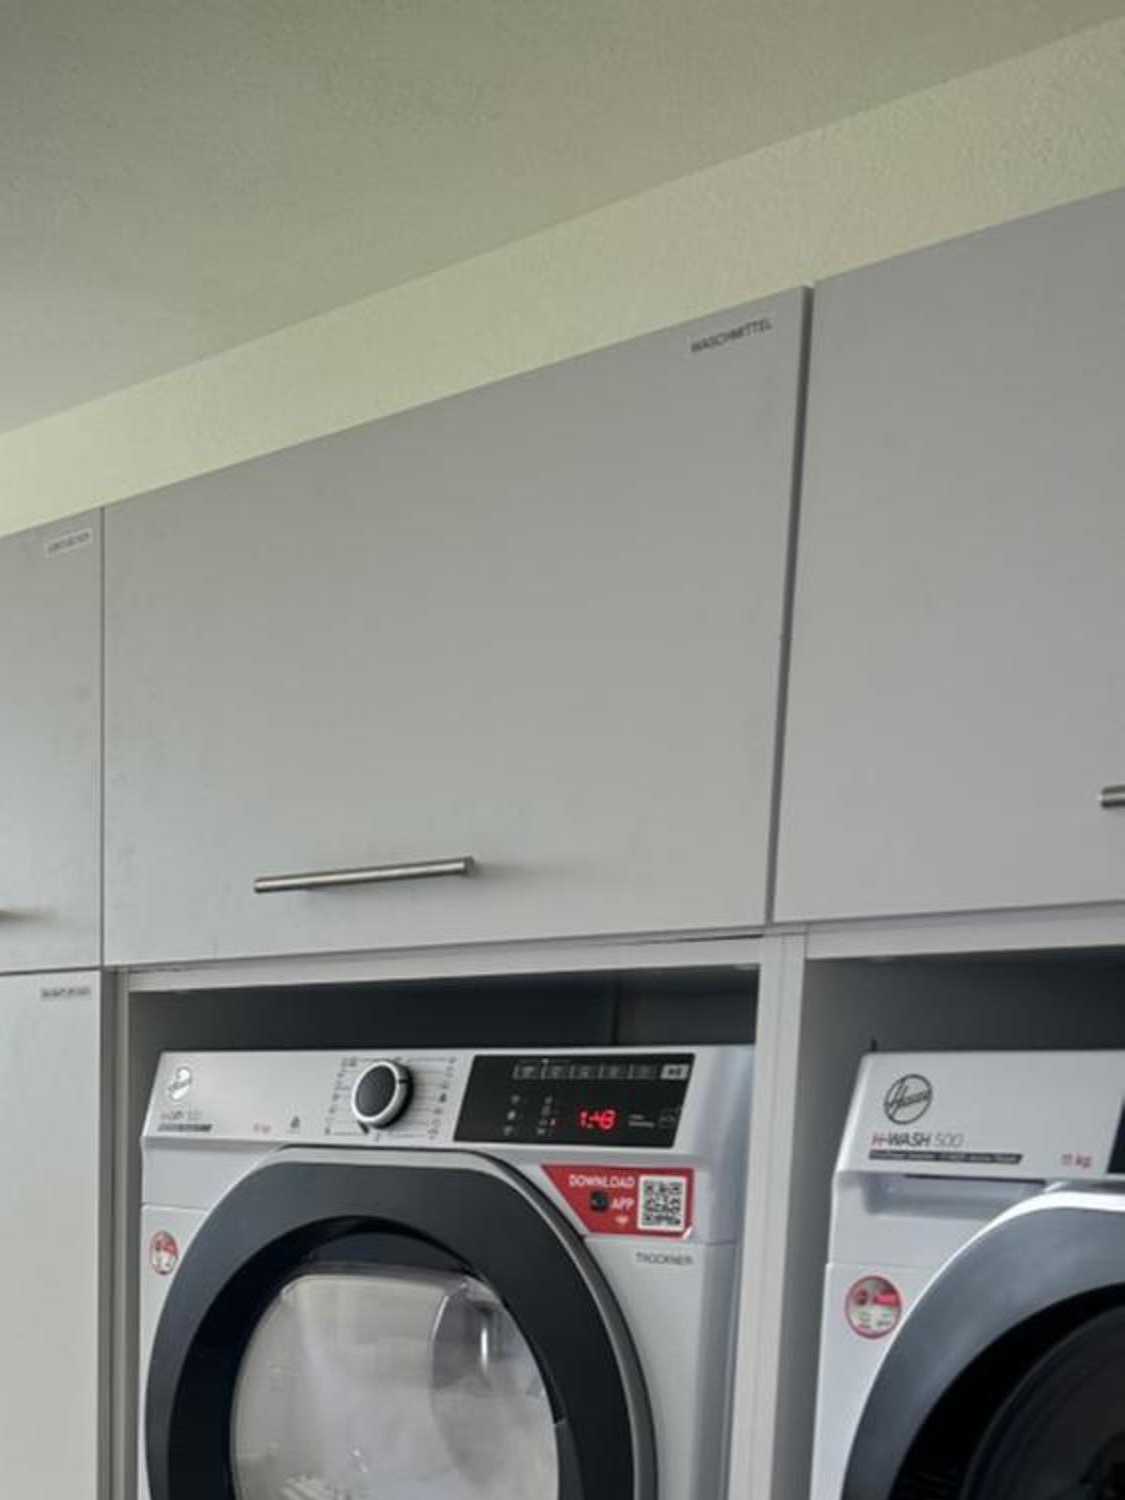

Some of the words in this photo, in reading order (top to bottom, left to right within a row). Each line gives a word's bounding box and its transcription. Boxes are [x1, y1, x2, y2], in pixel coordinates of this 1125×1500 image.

[691, 318, 773, 352] WASCHMITTEL
[934, 1132, 963, 1148] 500
[569, 1174, 635, 1189] DOWNLOAD
[611, 1197, 635, 1210] APP
